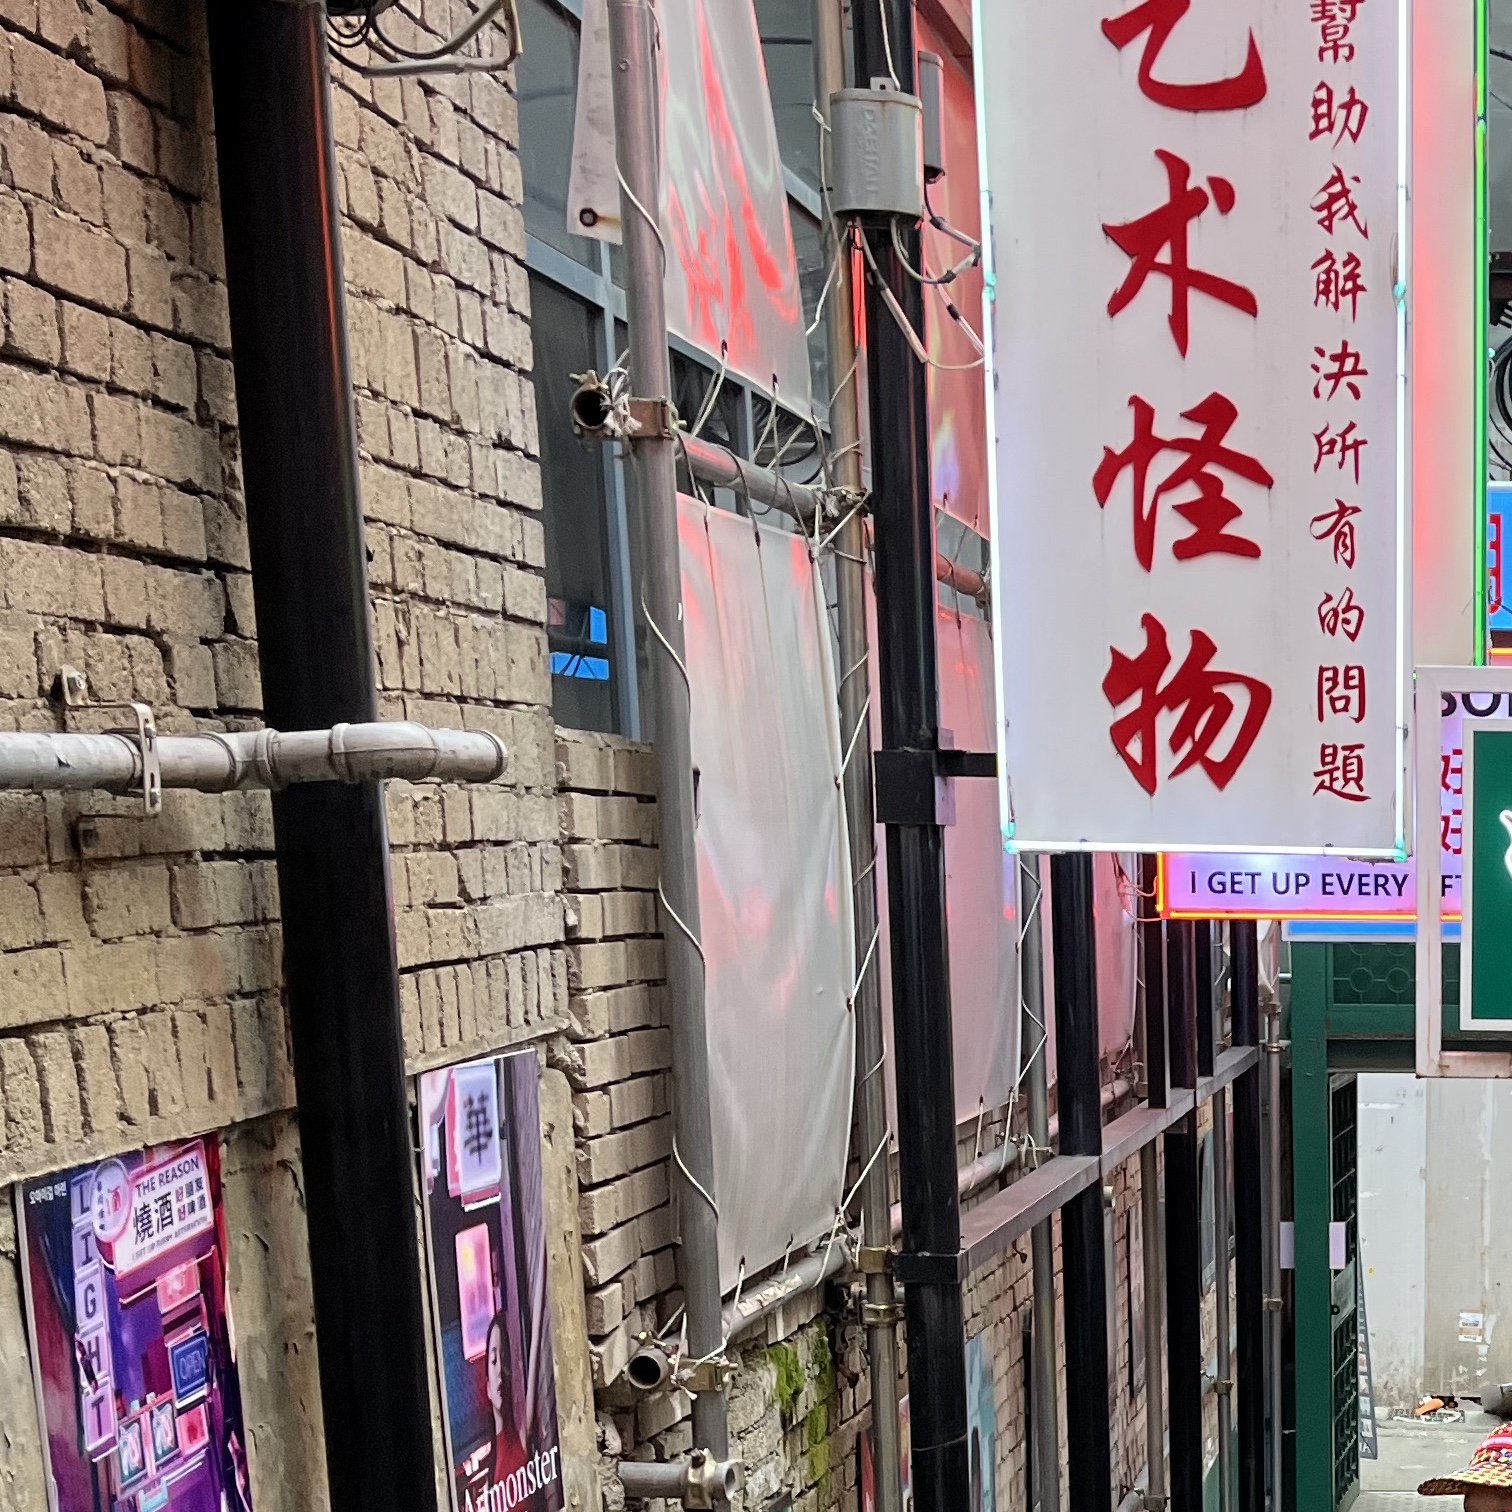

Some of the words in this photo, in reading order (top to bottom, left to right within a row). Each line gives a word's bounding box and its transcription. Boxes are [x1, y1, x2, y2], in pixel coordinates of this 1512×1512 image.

[1190, 870, 1197, 894] I
[1207, 870, 1262, 895] GET
[1272, 871, 1311, 895] UP
[1321, 872, 1409, 898] EVERY
[135, 1176, 156, 1198] THE
[158, 1155, 200, 1187] REASON
